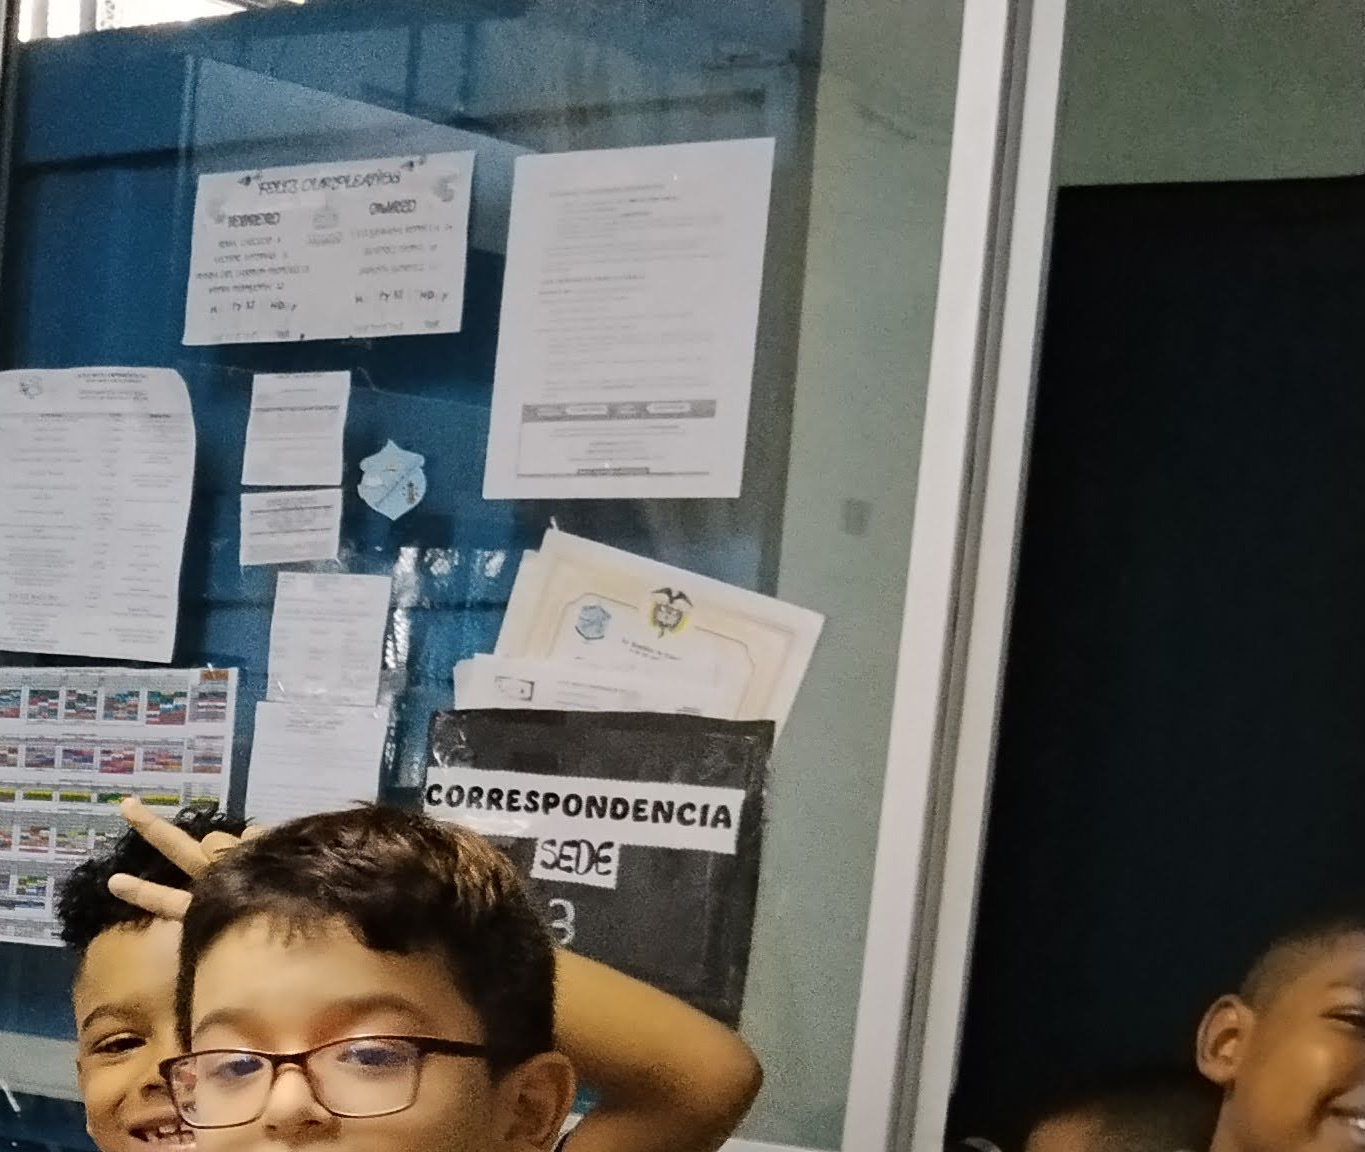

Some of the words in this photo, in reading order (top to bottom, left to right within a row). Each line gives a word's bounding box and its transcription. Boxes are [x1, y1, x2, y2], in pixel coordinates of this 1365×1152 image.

[425, 783, 732, 829] CORRESPONDENCIA
[540, 839, 614, 876] SEDE
[548, 898, 576, 946] 3
